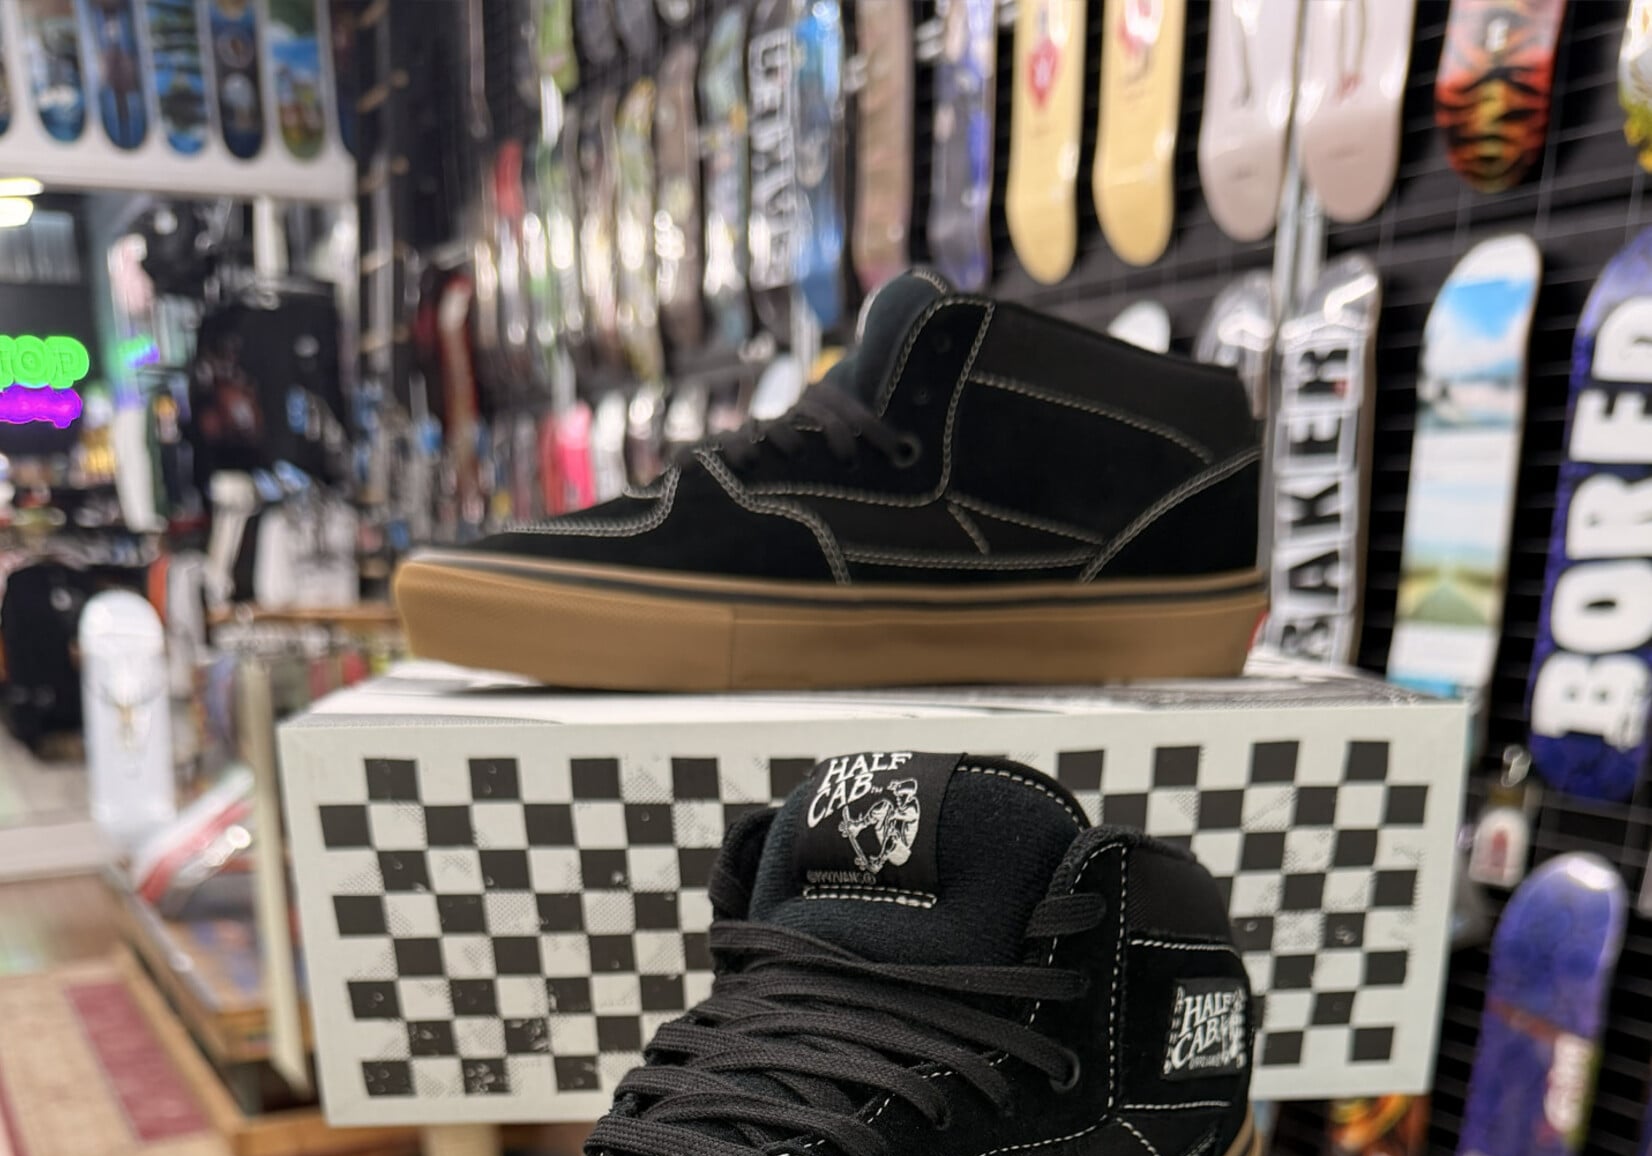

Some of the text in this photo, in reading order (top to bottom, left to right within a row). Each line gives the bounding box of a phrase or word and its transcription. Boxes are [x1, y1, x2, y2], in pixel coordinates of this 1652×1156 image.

[1531, 298, 1652, 754] BORED
[816, 752, 913, 794] HALF
[807, 773, 874, 828] CAB
[1178, 991, 1233, 1038] HALF
[1171, 1017, 1221, 1070] CAB
